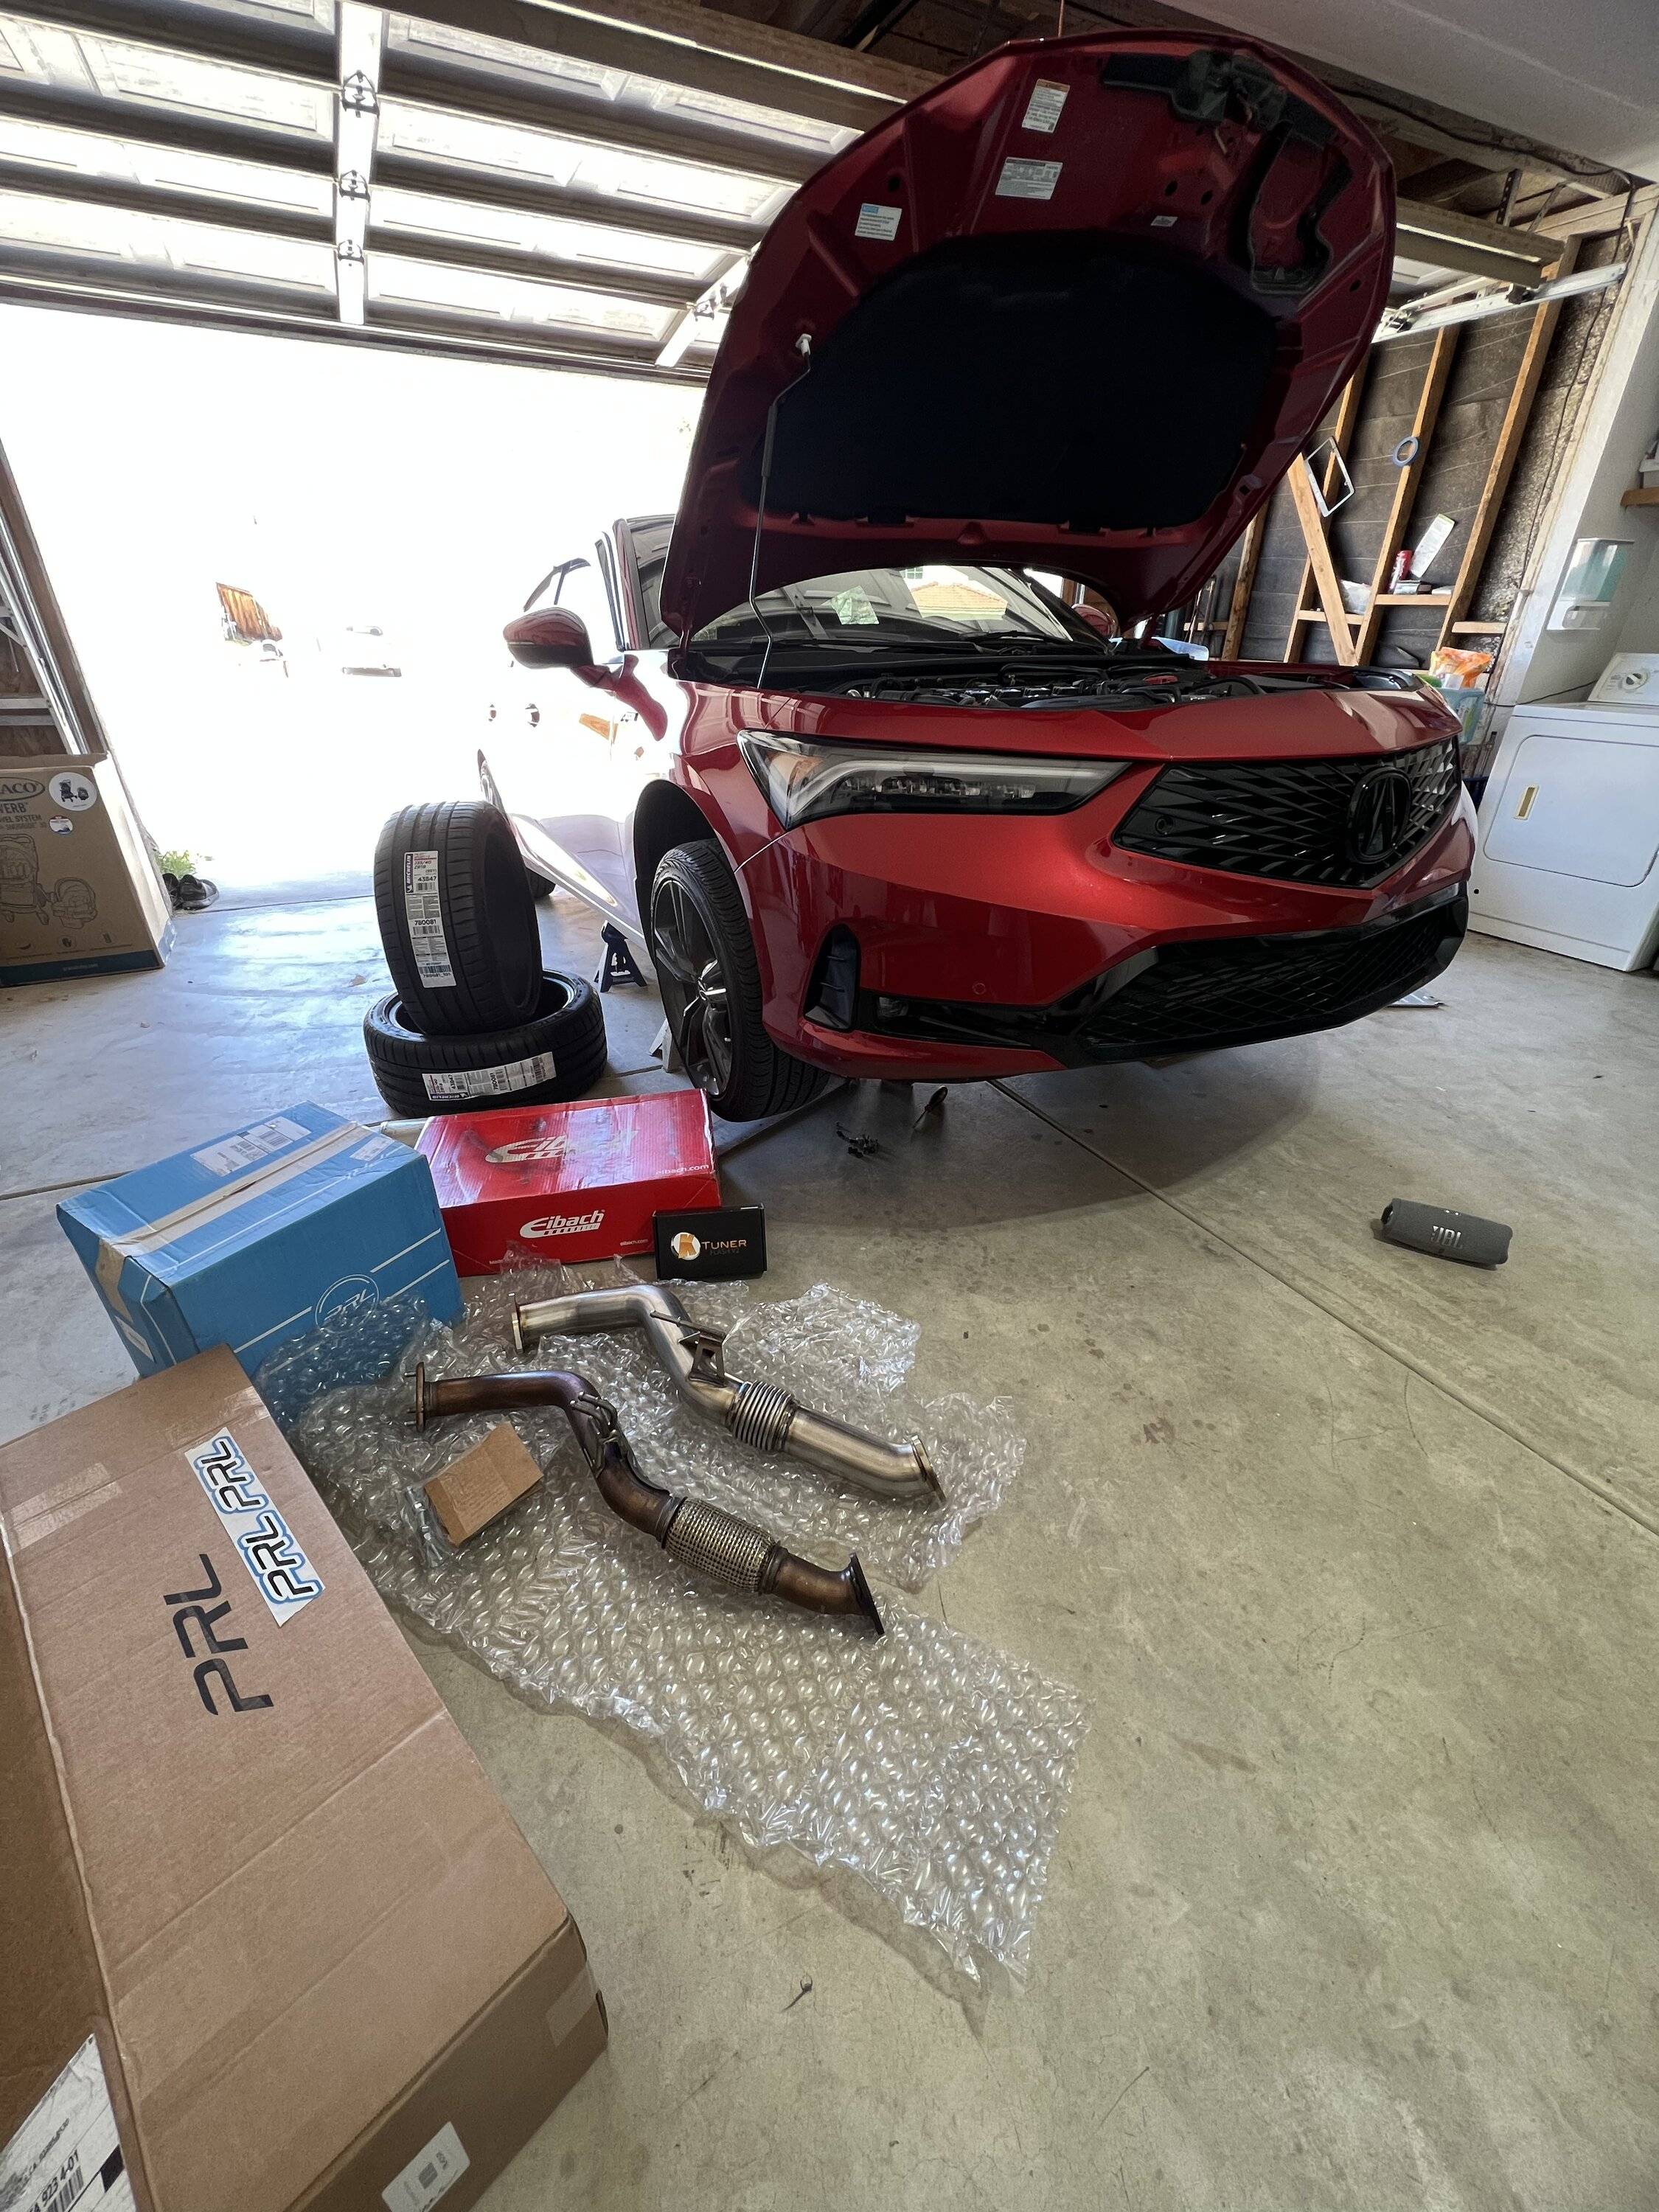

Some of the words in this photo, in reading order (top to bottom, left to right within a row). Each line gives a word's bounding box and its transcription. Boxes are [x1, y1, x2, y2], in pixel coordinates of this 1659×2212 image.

[0, 782, 37, 794] ACO
[15, 814, 42, 822] SYSTEM
[520, 1209, 604, 1239] Eibach
[1432, 1225, 1464, 1250] JBL
[201, 1440, 261, 1510] PRL
[245, 1515, 316, 1598] PRL
[163, 1554, 274, 1717] PRL
